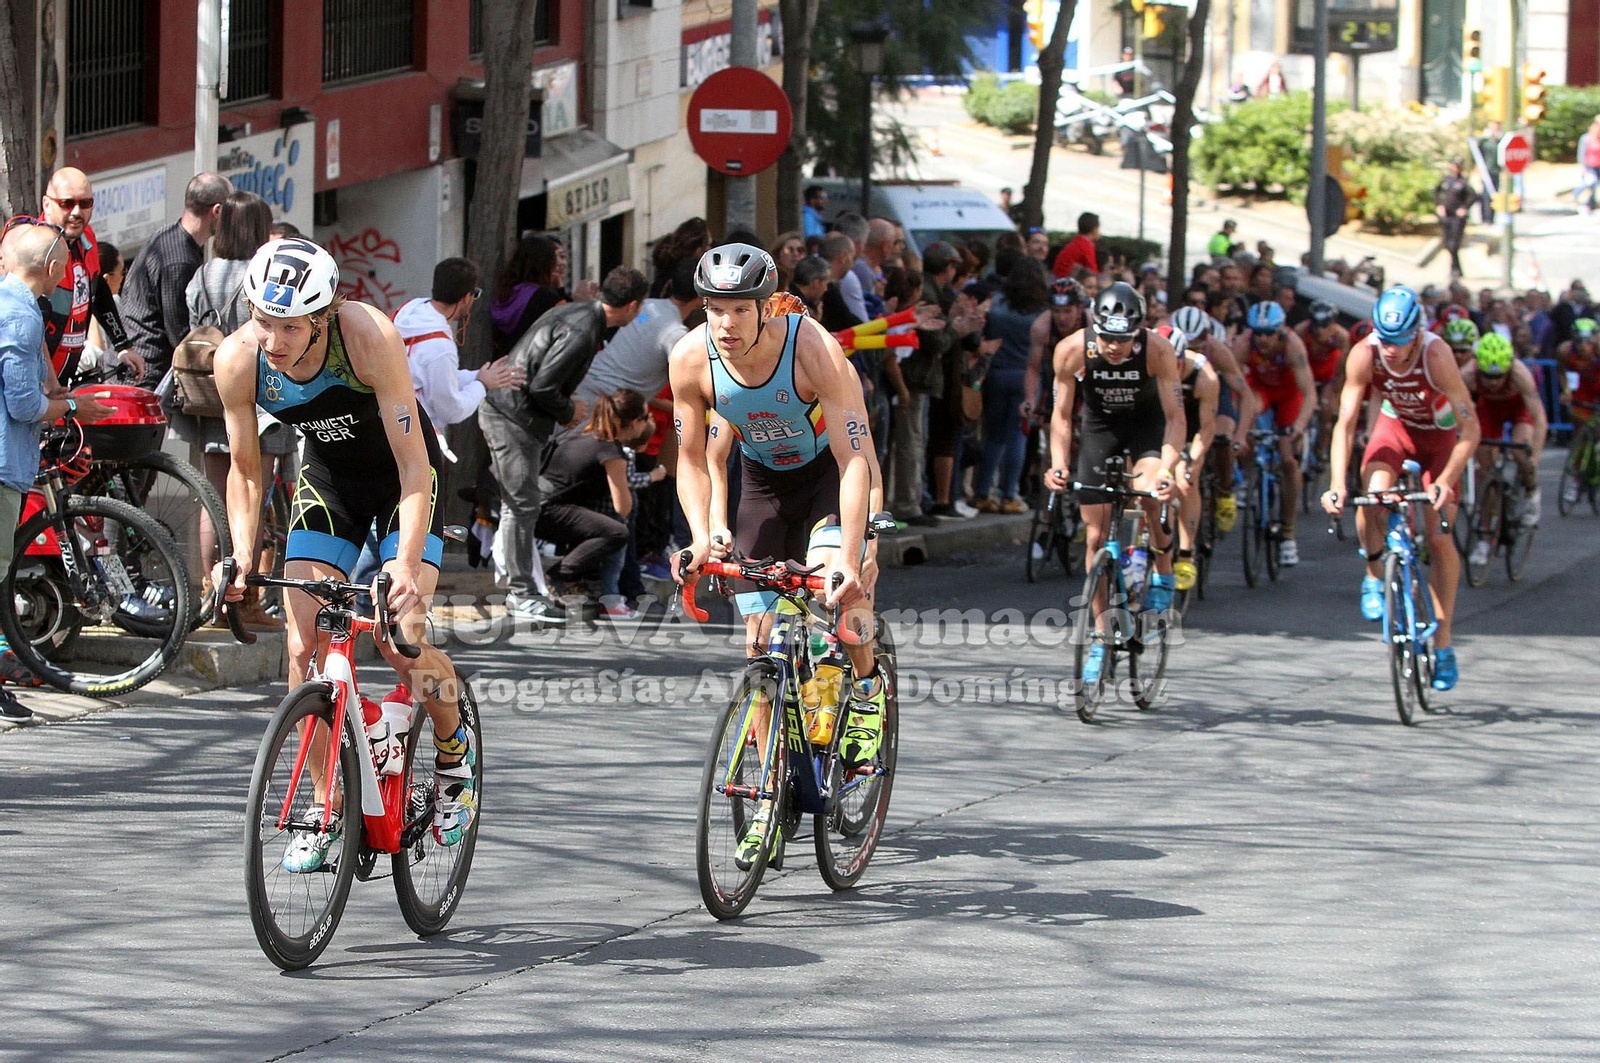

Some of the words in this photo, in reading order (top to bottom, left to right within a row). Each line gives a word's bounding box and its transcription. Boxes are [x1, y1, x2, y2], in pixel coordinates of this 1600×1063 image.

[565, 177, 609, 216] SEIKO
[271, 286, 287, 303] 7
[265, 304, 287, 315] uvex
[1093, 370, 1140, 380] HUUB
[397, 415, 412, 436] 7
[316, 427, 356, 443] GER
[749, 426, 805, 443] BEL
